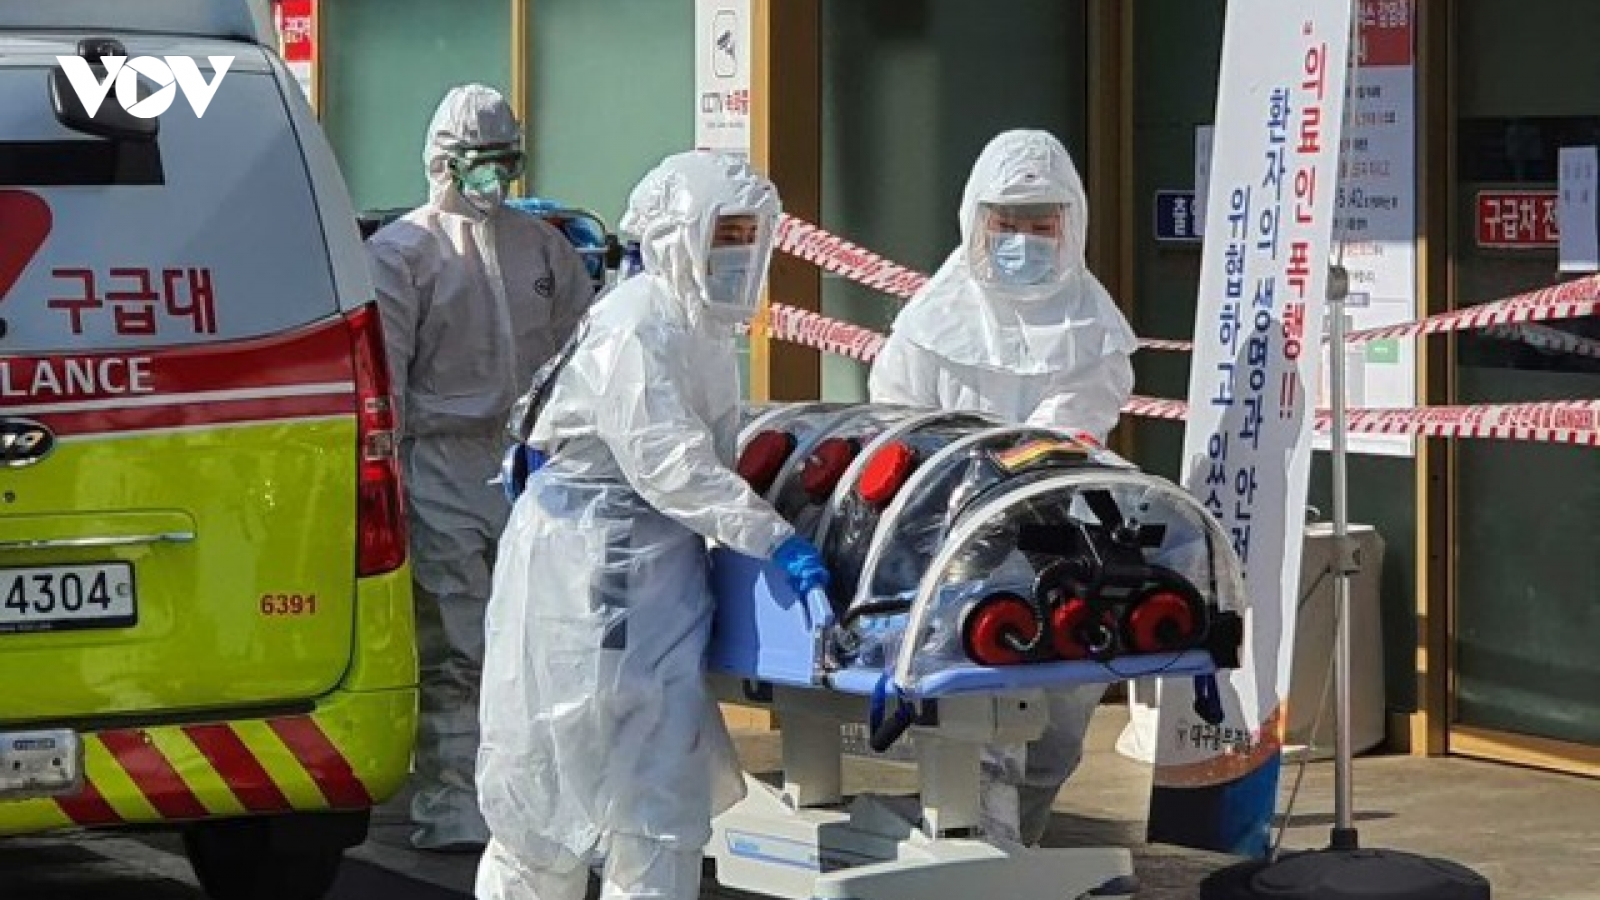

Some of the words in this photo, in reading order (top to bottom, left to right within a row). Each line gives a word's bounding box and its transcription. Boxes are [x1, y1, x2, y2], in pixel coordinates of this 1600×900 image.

[1294, 42, 1328, 224] 의료인
[1257, 87, 1291, 260] 환자의
[1484, 199, 1538, 241] 구급차
[47, 267, 216, 335] 구급대
[1209, 185, 1251, 406] 위협하고
[0, 357, 155, 396] LANCE
[1239, 277, 1275, 450] 생명과
[4, 569, 111, 615] 4304
[259, 594, 318, 615] 6391
